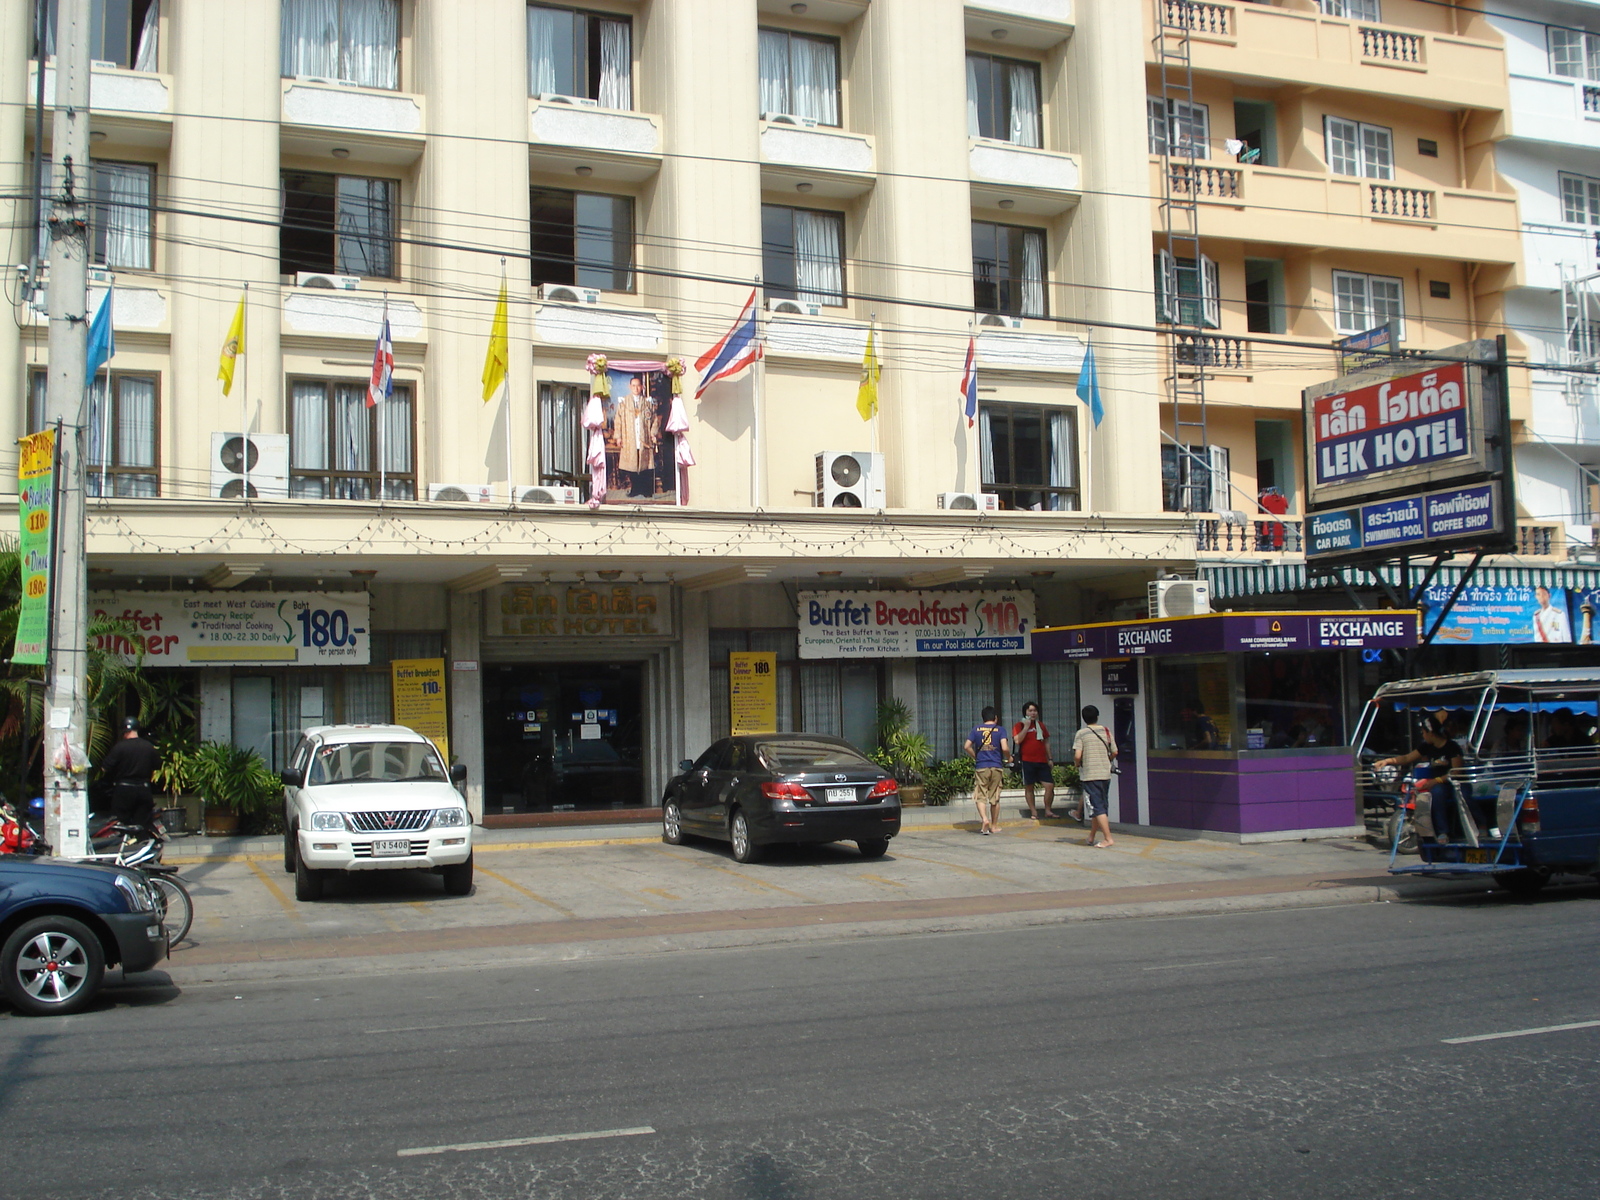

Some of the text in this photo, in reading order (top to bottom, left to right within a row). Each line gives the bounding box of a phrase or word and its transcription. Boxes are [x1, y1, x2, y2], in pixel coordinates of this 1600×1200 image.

[1321, 373, 1461, 439] เล็ก โฮเต็ล
[1322, 418, 1463, 478] LEK HOTEL
[1432, 514, 1488, 532] COFFEE SHOP
[1365, 524, 1423, 543] SWIMMING POOL
[1316, 536, 1351, 550] CAR PARK
[183, 599, 200, 608] East
[226, 600, 246, 608] West
[250, 600, 276, 608] Cuisine
[293, 601, 309, 610] Baht
[193, 611, 227, 621] Ordinary
[809, 600, 969, 627] Buffet Breakfast
[201, 621, 274, 632] Traditional Cooking
[502, 617, 658, 635] LEK HOTEL
[1320, 622, 1404, 637] EXCHANGE
[210, 632, 280, 642] 18.00-22.30 Daily
[822, 629, 834, 637] The
[915, 628, 966, 638] 07.00-13.00 Daily
[1118, 628, 1172, 646] EXCHANGE
[883, 637, 899, 645] Spicy
[923, 639, 1018, 650] in our Pool side Coffee Shop
[329, 648, 345, 657] person
[347, 648, 357, 657] only
[397, 668, 440, 678] Buffet Breakfast
[1108, 673, 1119, 681] ATM
[389, 841, 408, 849] 5408
